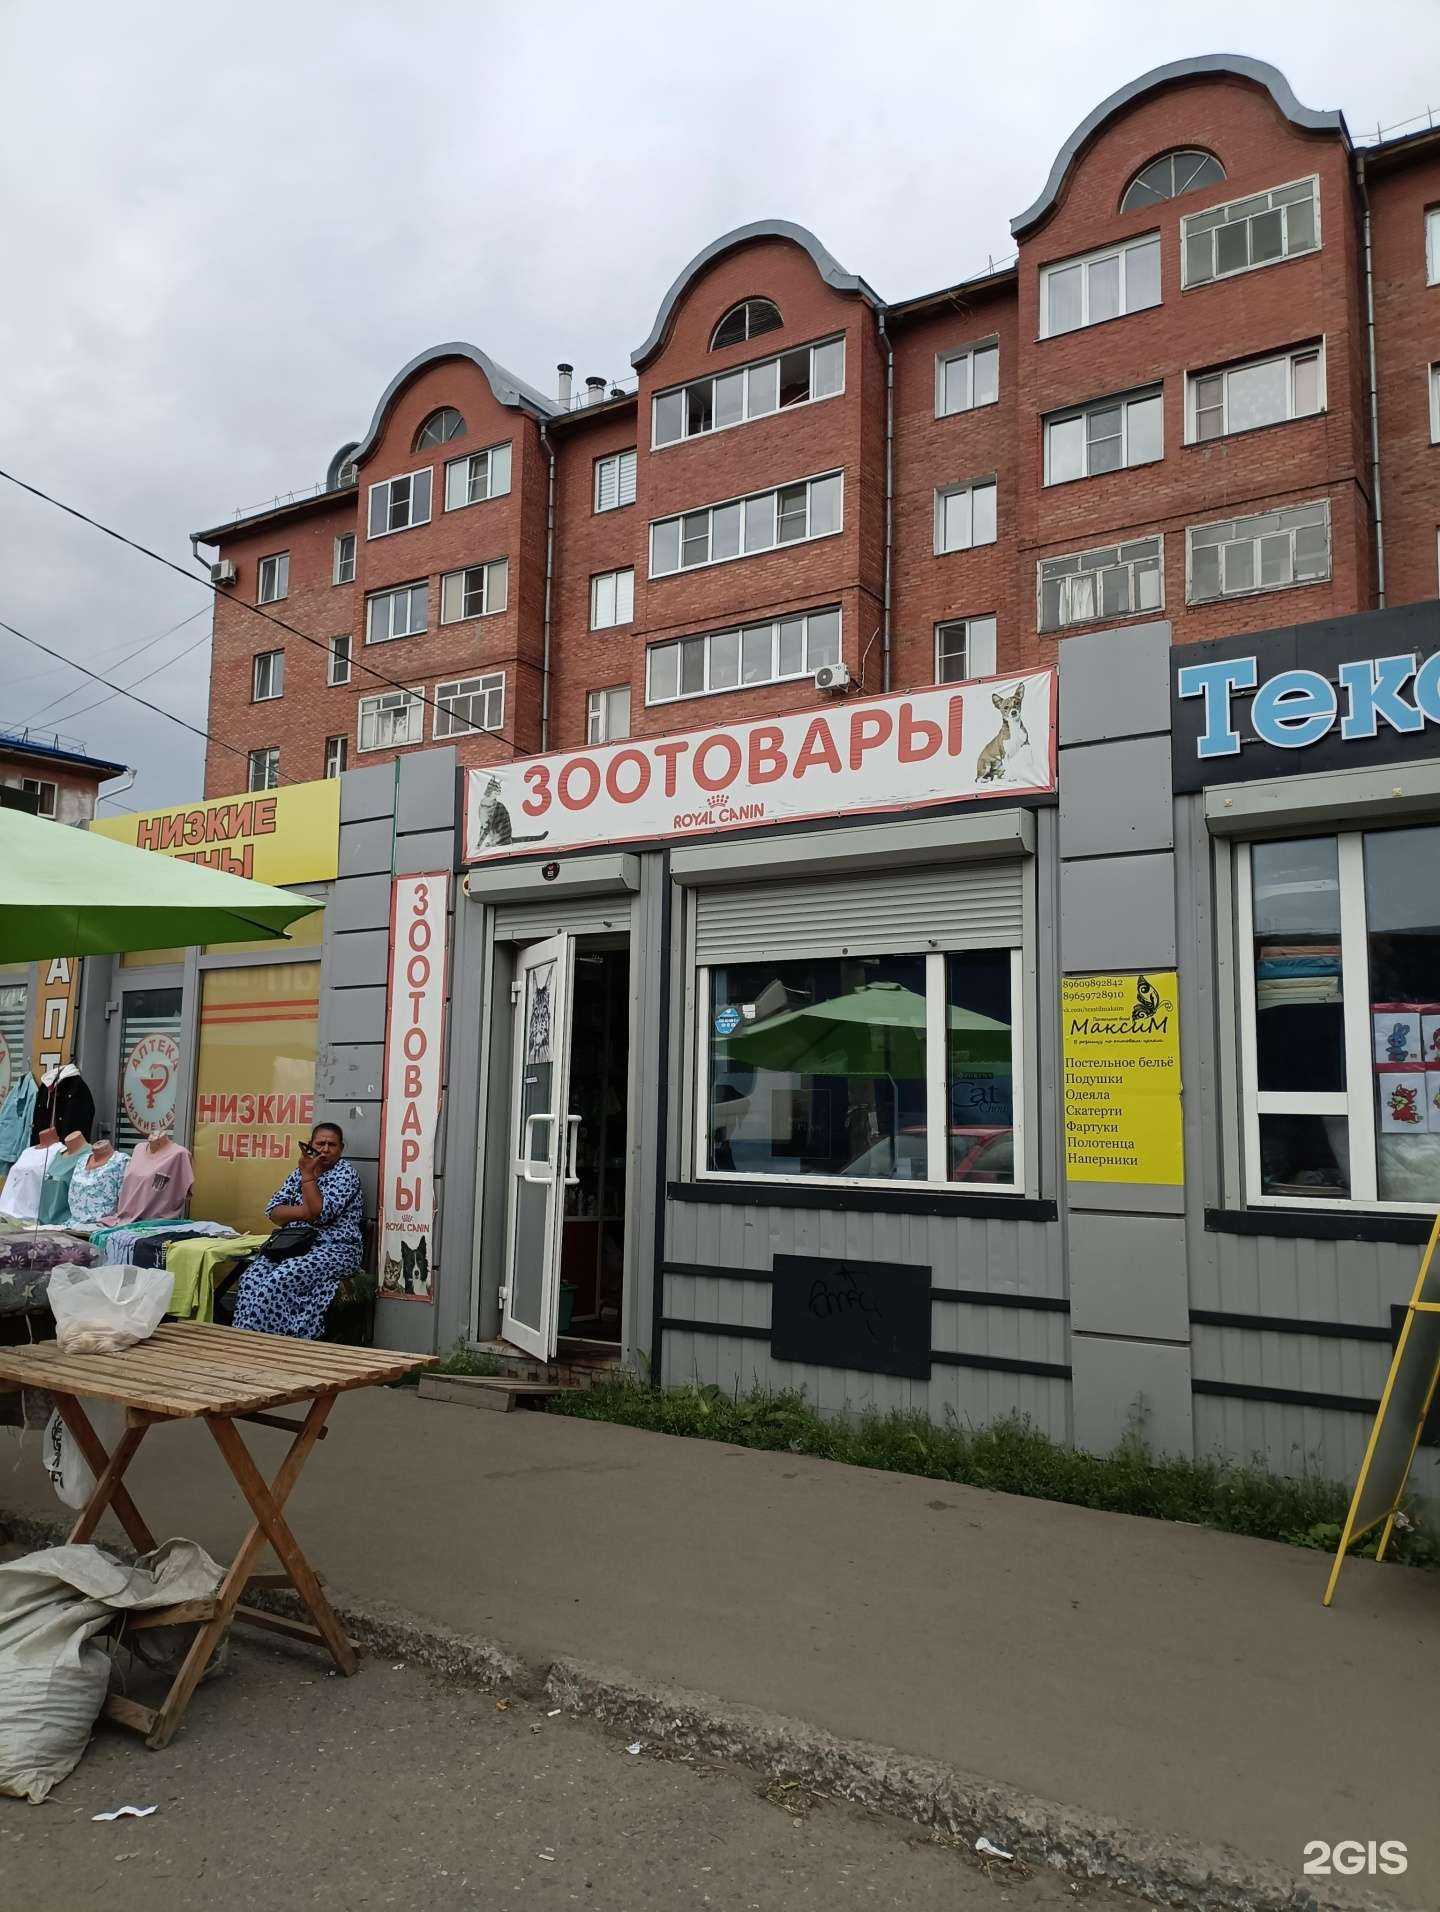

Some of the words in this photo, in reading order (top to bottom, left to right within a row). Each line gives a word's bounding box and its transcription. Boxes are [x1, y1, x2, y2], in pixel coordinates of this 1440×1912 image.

[522, 695, 963, 816] ЗООТОВАРЫ
[136, 797, 278, 850] НИЗКИЕ
[673, 811, 715, 828] ROYAL
[719, 802, 764, 822] CANIN
[169, 844, 254, 880] НЫ
[1063, 991, 1124, 1001] 89659728910
[39, 957, 71, 1074] АПТ
[131, 1039, 179, 1072] АПТЕКА
[395, 883, 431, 1212] ЗООТОВАРЫ
[1065, 1057, 1135, 1068] Постельное
[1138, 1056, 1174, 1068] бельё
[1066, 1073, 1123, 1086] Подушки
[950, 1081, 1001, 1108] Cat
[1066, 1088, 1110, 1100] Одеяла
[198, 1092, 314, 1125] НИЗКИЕ
[1066, 1105, 1122, 1118] Скатерти
[1066, 1121, 1118, 1134] Фартуки
[217, 1132, 292, 1161] ЦЕНЫ
[1068, 1137, 1134, 1149] Полотенца
[1068, 1153, 1138, 1166] Наперники
[385, 1223, 406, 1232] ROYAL
[407, 1223, 430, 1232] CANIN
